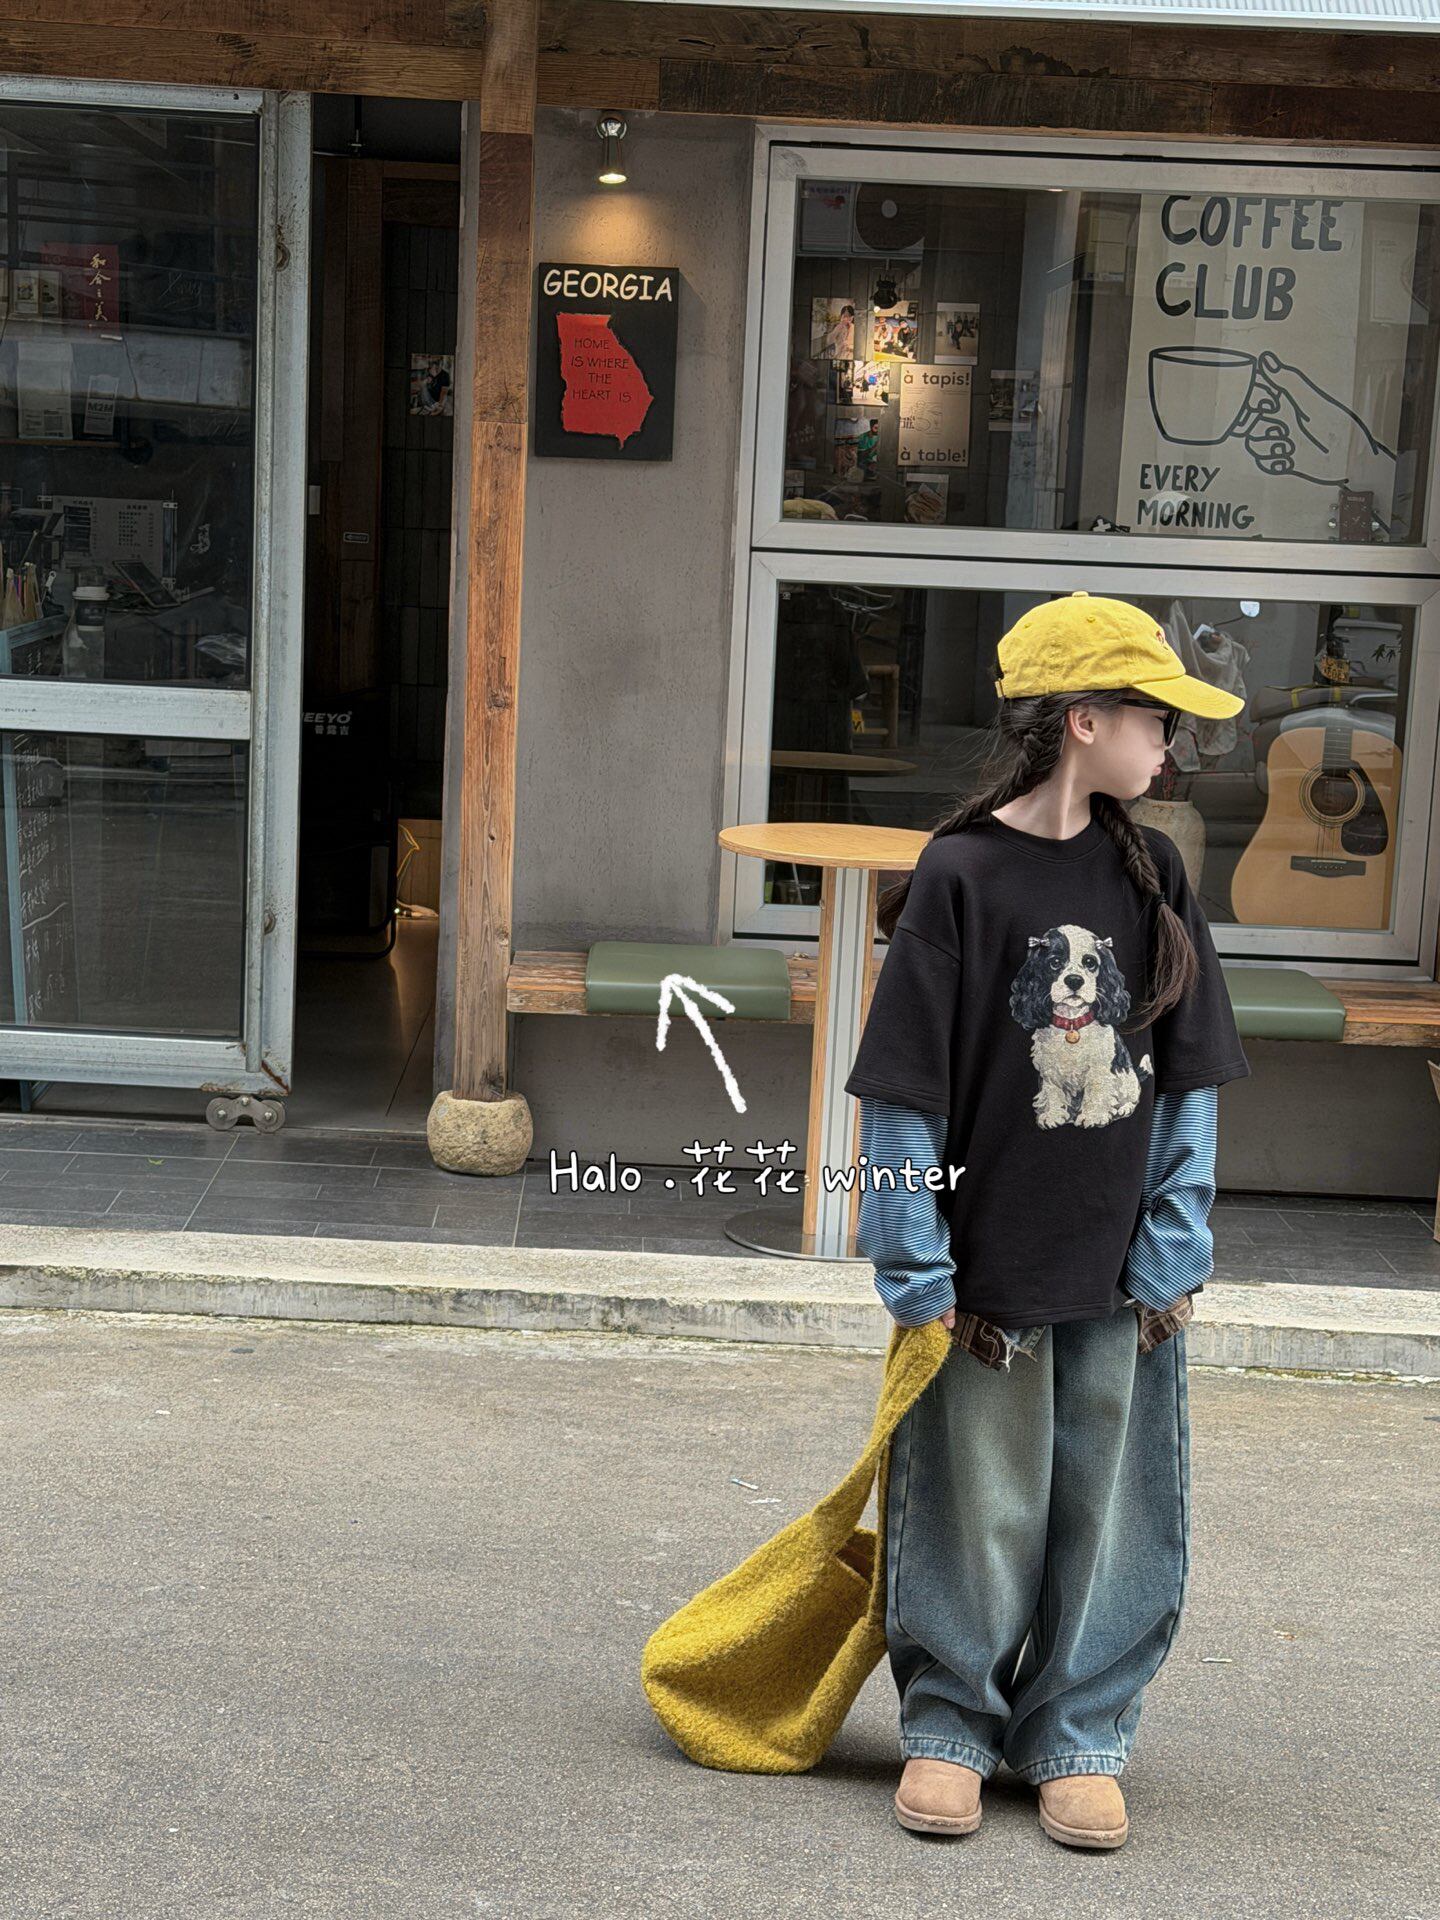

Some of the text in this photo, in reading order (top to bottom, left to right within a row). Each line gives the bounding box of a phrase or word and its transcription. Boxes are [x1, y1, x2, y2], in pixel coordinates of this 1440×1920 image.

[1161, 195, 1344, 251] COFFEE
[543, 269, 673, 302] GEORGIA
[1155, 261, 1297, 321] CLUB
[574, 338, 610, 350] HOME
[571, 355, 629, 370] IS WHERE
[588, 372, 612, 385] THE
[922, 371, 970, 388] tapis!
[572, 389, 632, 403] HEART IS
[918, 448, 966, 462] table!
[1139, 463, 1221, 492] EVERY
[1136, 499, 1256, 530] MORNING
[302, 711, 351, 724] EEYO
